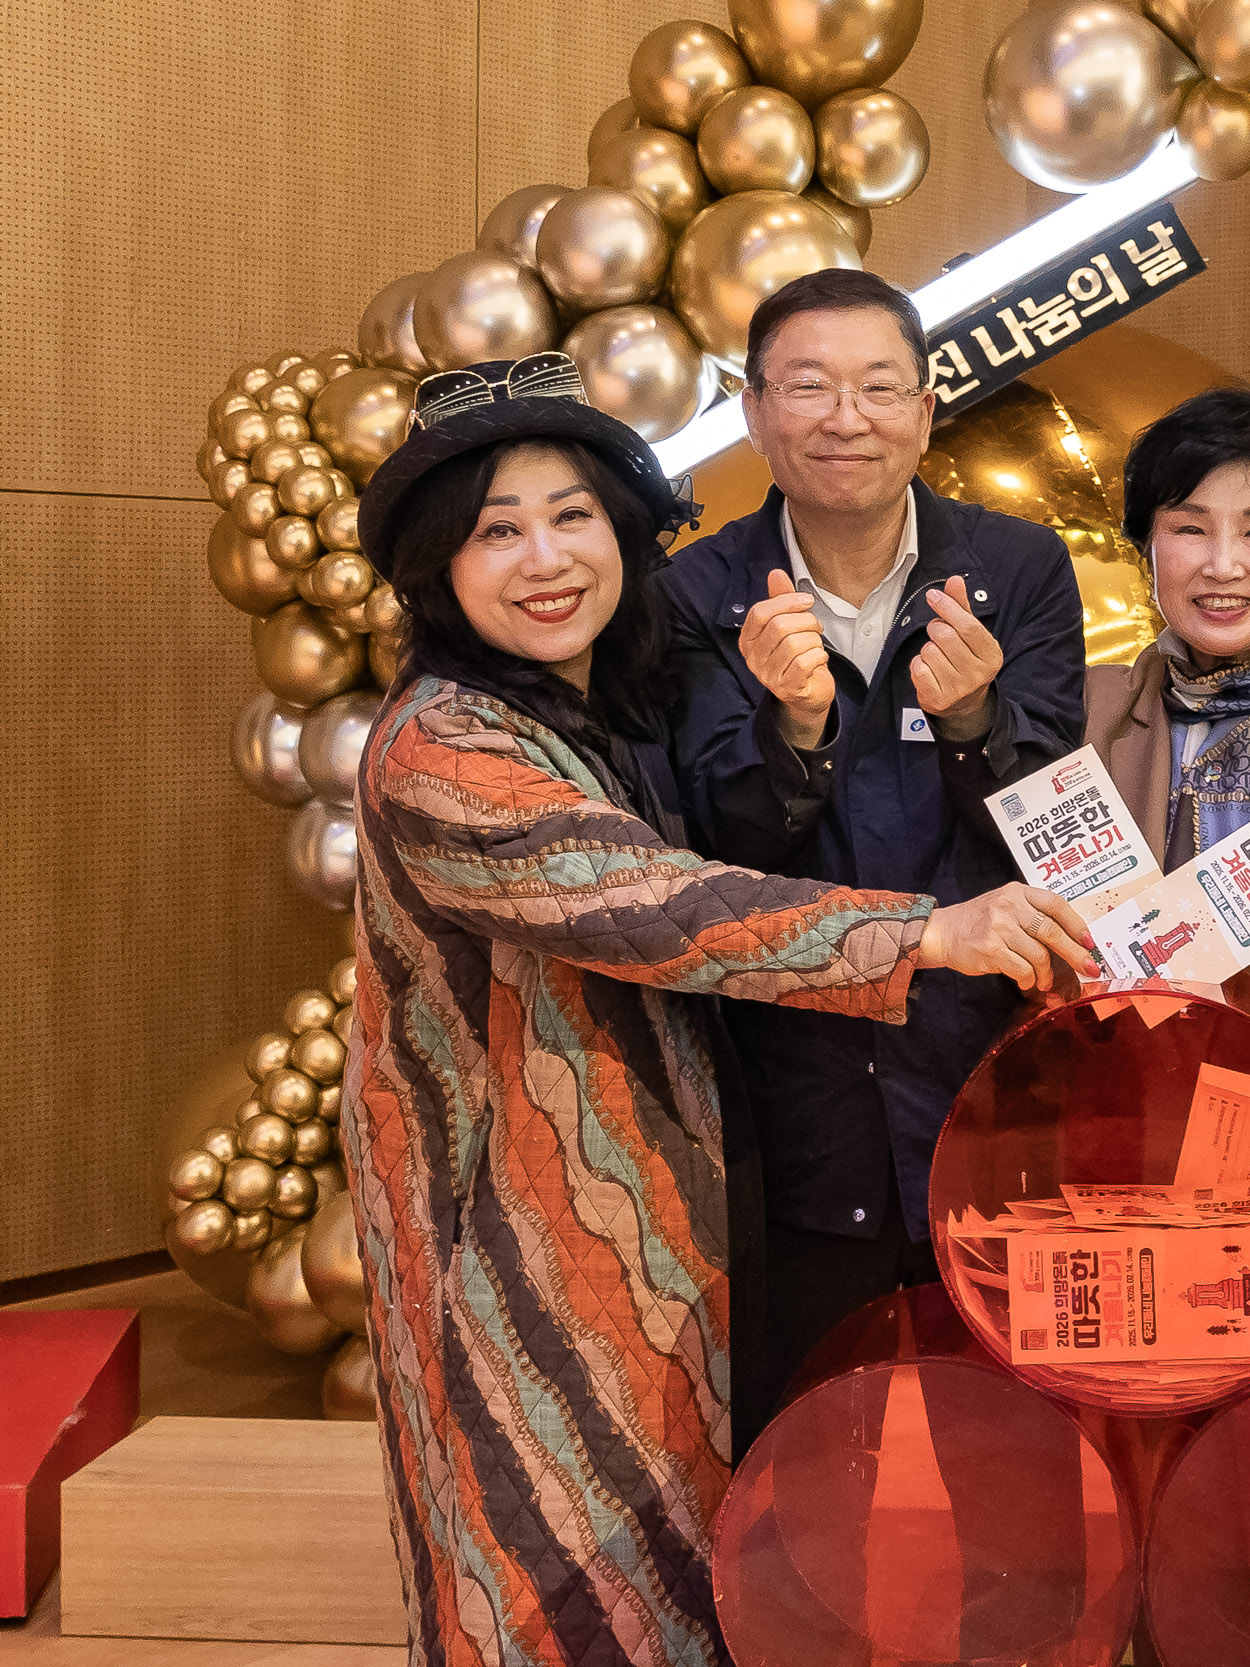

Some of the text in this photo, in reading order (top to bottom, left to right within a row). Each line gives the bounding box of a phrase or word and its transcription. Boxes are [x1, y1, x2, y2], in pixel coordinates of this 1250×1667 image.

[970, 253, 1130, 368] 나눔의
[1120, 220, 1188, 288] 날
[1016, 785, 1102, 838] 2026 희망온돌
[1022, 800, 1114, 863] 따뜻한
[1036, 825, 1125, 882] 겨울나기
[1052, 1251, 1070, 1348] 2026 희망온돌
[1069, 1249, 1101, 1349] 따뜻한
[1101, 1250, 1124, 1347] 겨울나기
